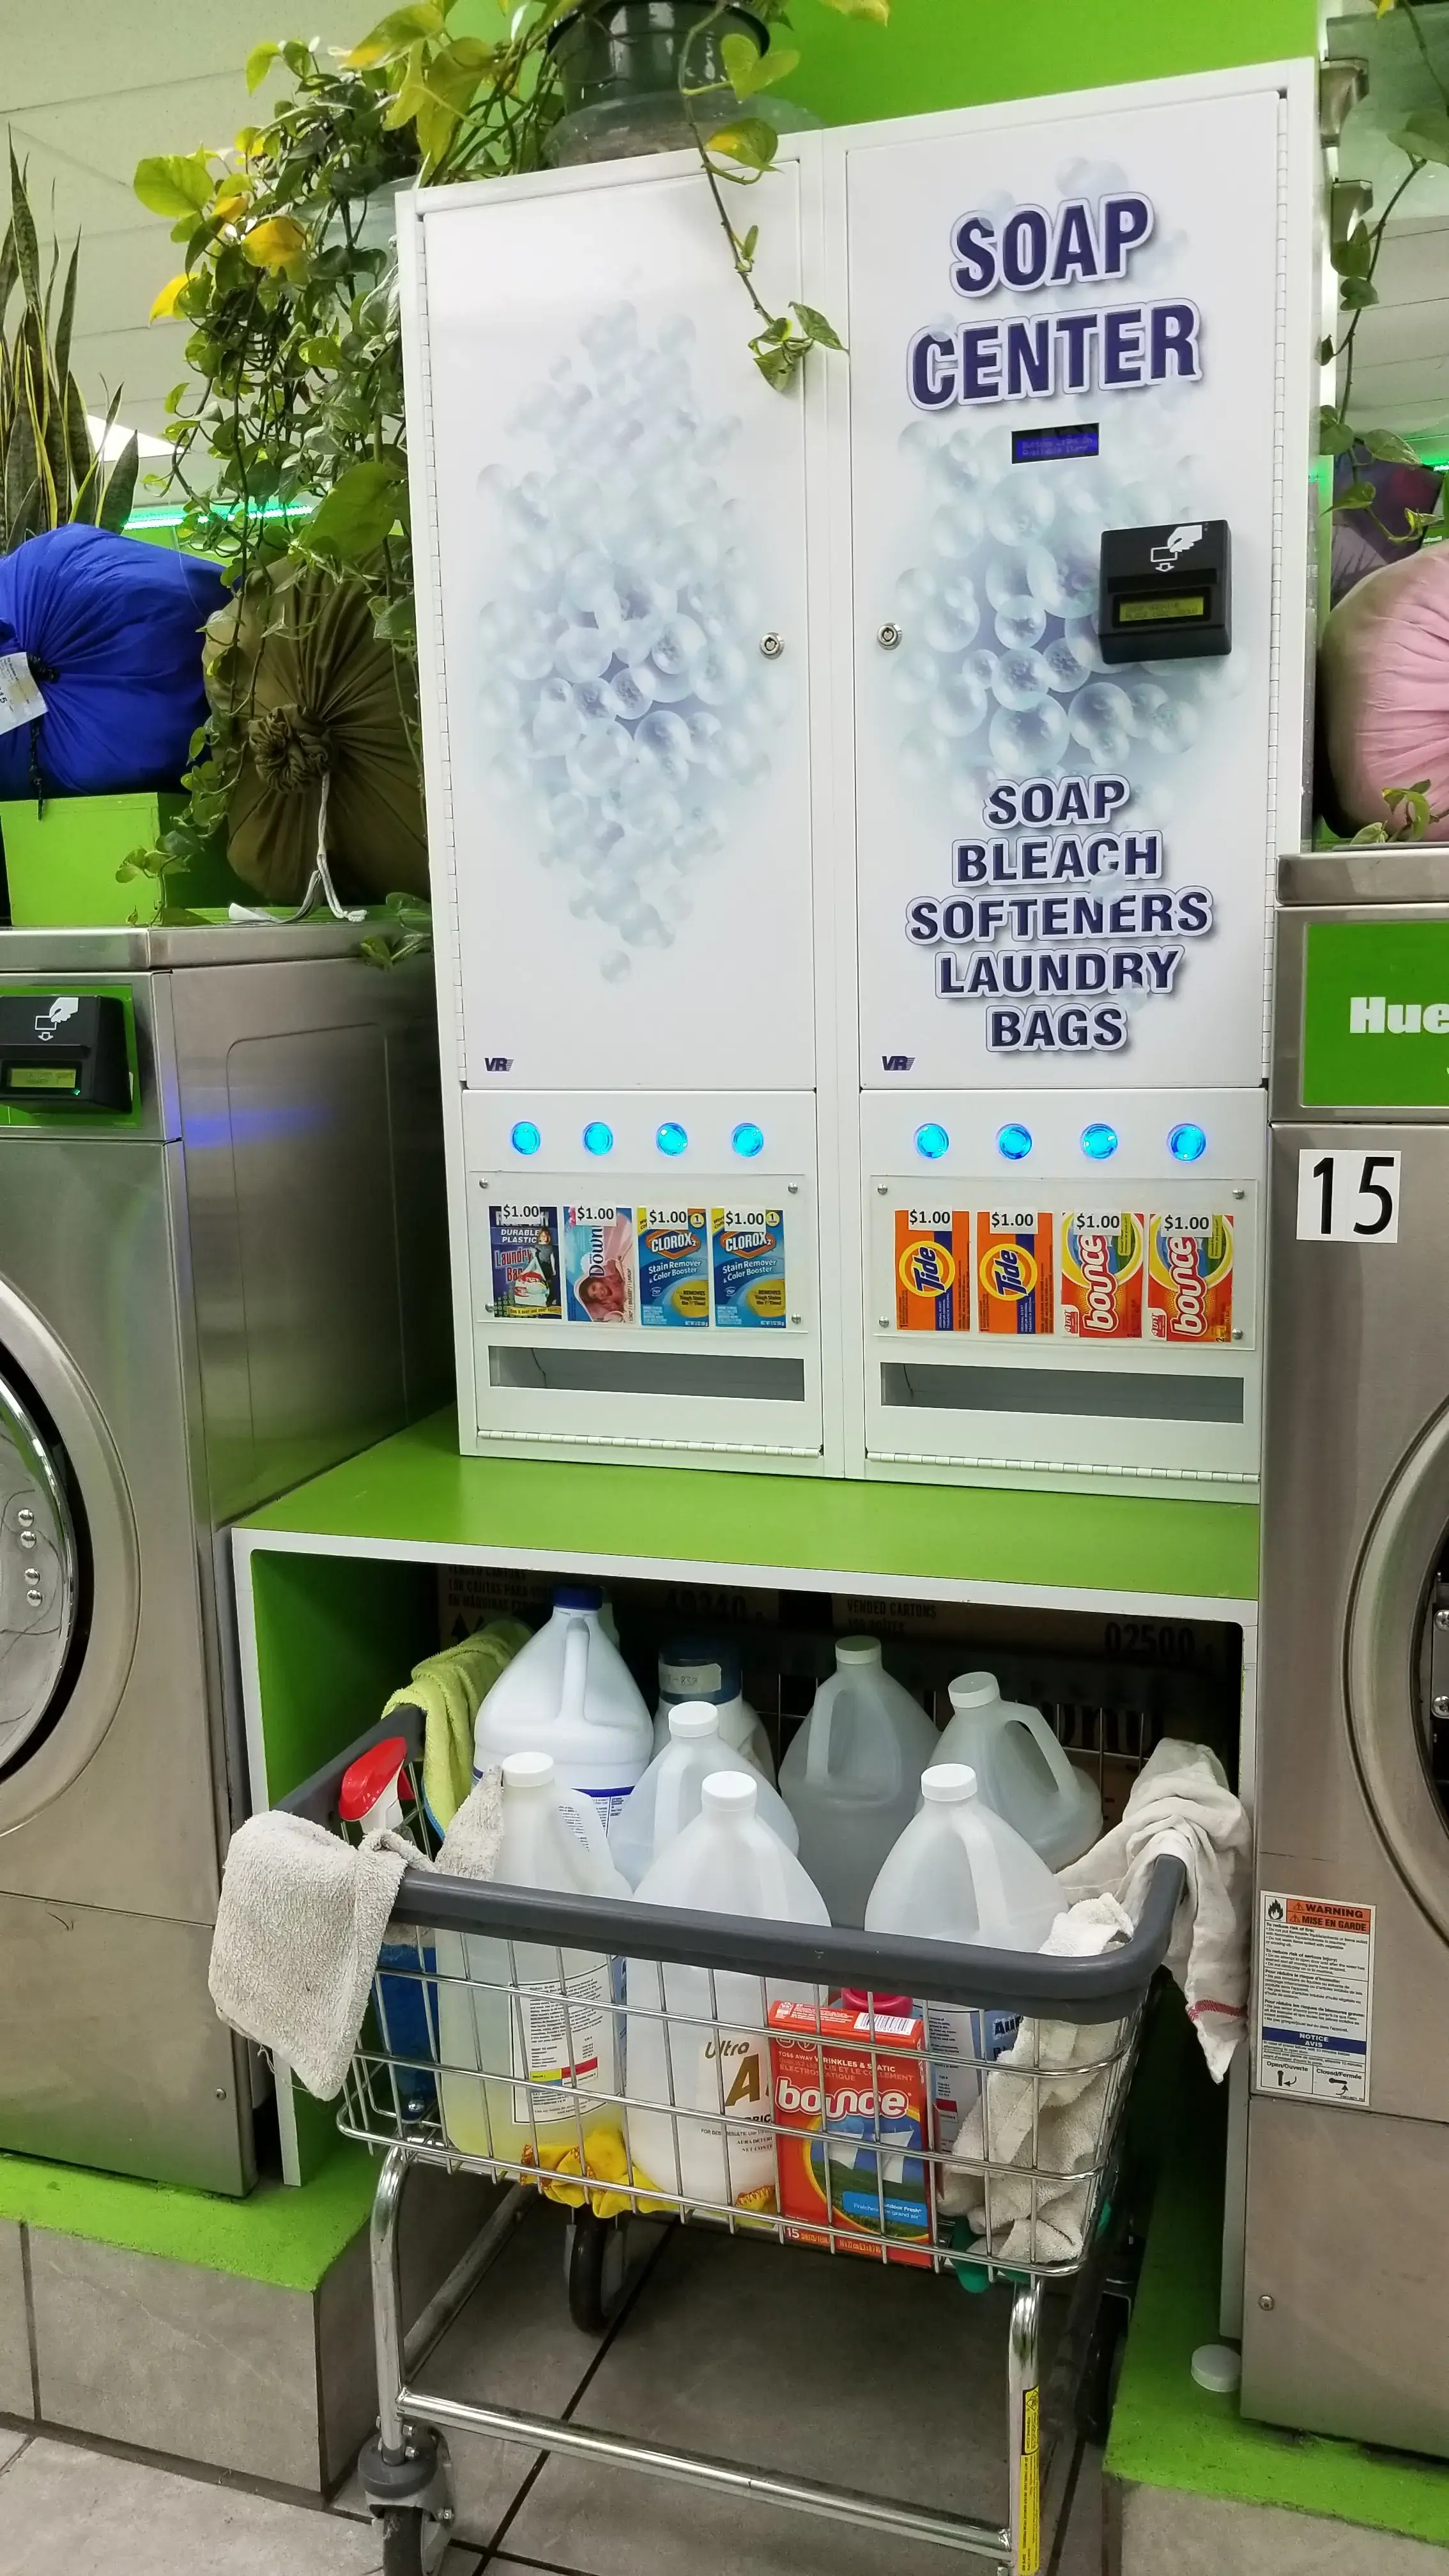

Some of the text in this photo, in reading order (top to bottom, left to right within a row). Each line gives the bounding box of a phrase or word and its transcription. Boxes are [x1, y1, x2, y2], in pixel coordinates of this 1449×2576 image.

[954, 196, 1150, 293] SOAP
[912, 302, 1197, 407] CENTER
[988, 779, 1126, 825] SOAP
[956, 836, 1158, 881] BLEACH
[911, 893, 1209, 939] SOFTENERS
[940, 951, 1179, 993] LAUNDRY
[1349, 996, 1449, 1034] Hue
[992, 1009, 1123, 1048] BAGS
[1313, 1155, 1395, 1236] 15
[503, 1204, 539, 1219] $1.00
[578, 1206, 614, 1221] $1.00
[649, 1209, 687, 1225] $1.00
[725, 1211, 764, 1226] $1.00
[909, 1209, 951, 1225] $1.00
[992, 1211, 1034, 1228] $1.00
[1077, 1213, 1120, 1230] $1.00
[1164, 1215, 1209, 1232] $1.00
[589, 1226, 605, 1278] Down
[648, 1261, 702, 1275] Stain Remover
[653, 1271, 671, 1282] Color
[671, 1268, 697, 1277] Booster
[723, 1261, 743, 1274] Stain
[727, 1270, 745, 1281] Color
[746, 1266, 772, 1276] Booster
[913, 1246, 946, 1292] Tide
[994, 1250, 1028, 1296] Tide
[1079, 1234, 1116, 1331] bounce
[1169, 1236, 1204, 1335] bounce
[847, 1599, 937, 1618] VENDED CARTONS
[1305, 1903, 1363, 1919] WARNING
[1301, 1915, 1367, 1931] MISE EN GARDE
[1299, 2032, 1329, 2043] NOTICE
[705, 2040, 750, 2059] Ultra
[778, 2051, 793, 2059] TOSS
[795, 2053, 813, 2063] AWAY
[866, 2063, 896, 2073] SATIC
[862, 2070, 914, 2082] COLEMENT
[778, 2076, 908, 2120] bounce
[884, 2202, 903, 2211] utdoor
[786, 2227, 800, 2239] 15
